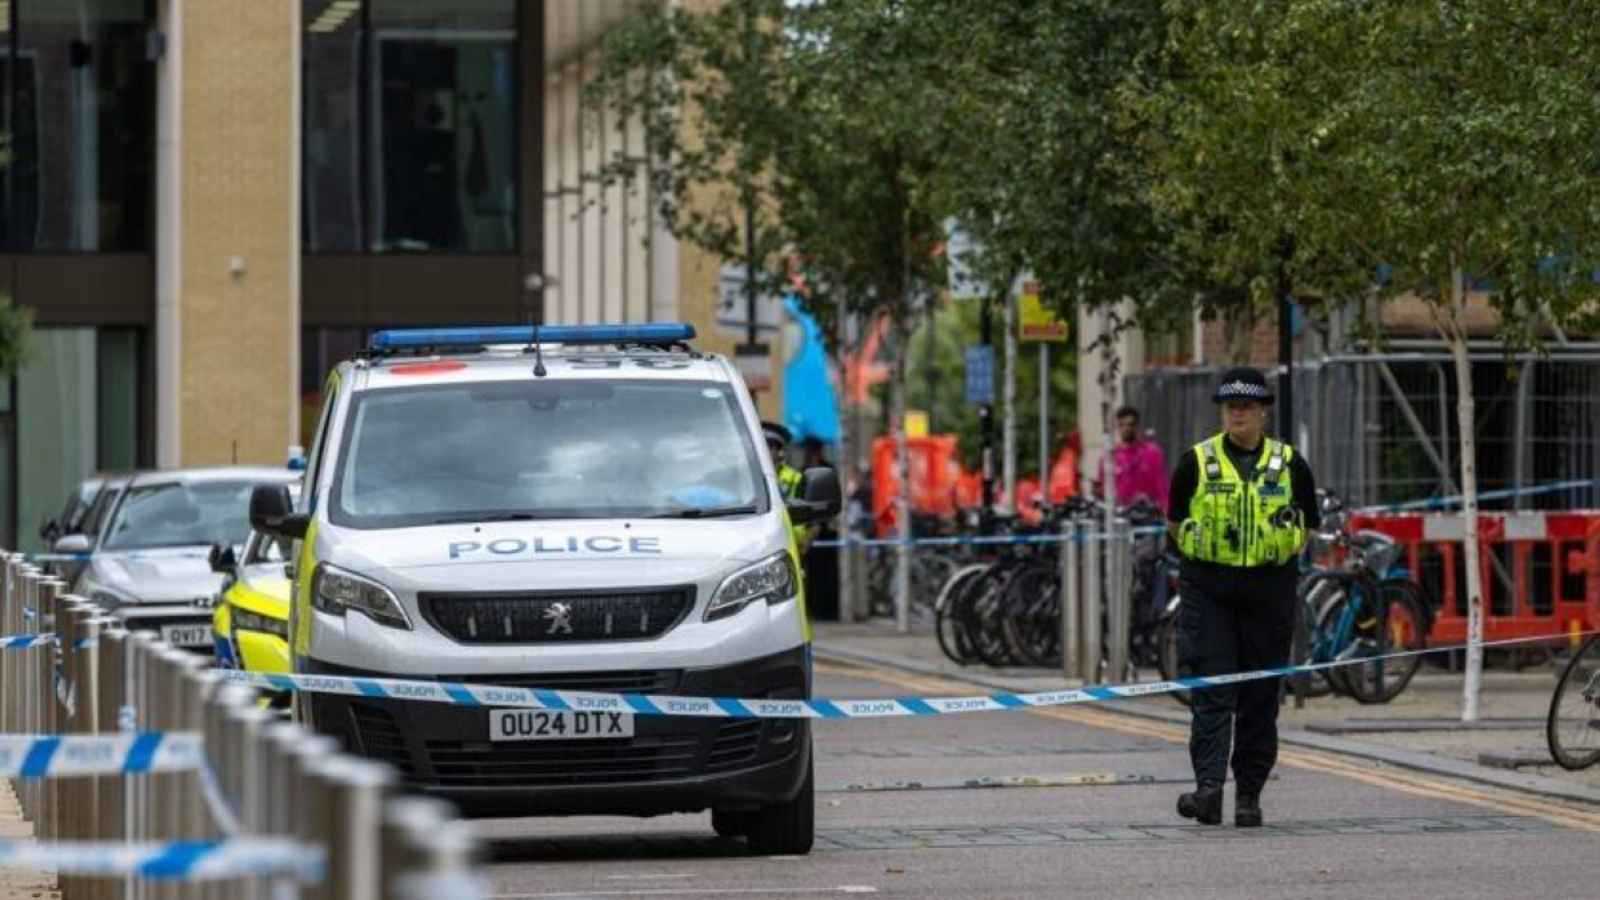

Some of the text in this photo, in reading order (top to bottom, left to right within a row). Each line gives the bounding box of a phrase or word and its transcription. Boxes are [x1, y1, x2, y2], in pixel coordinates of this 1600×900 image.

[449, 536, 662, 558] POLICE
[502, 710, 623, 737] OU24 DTX
